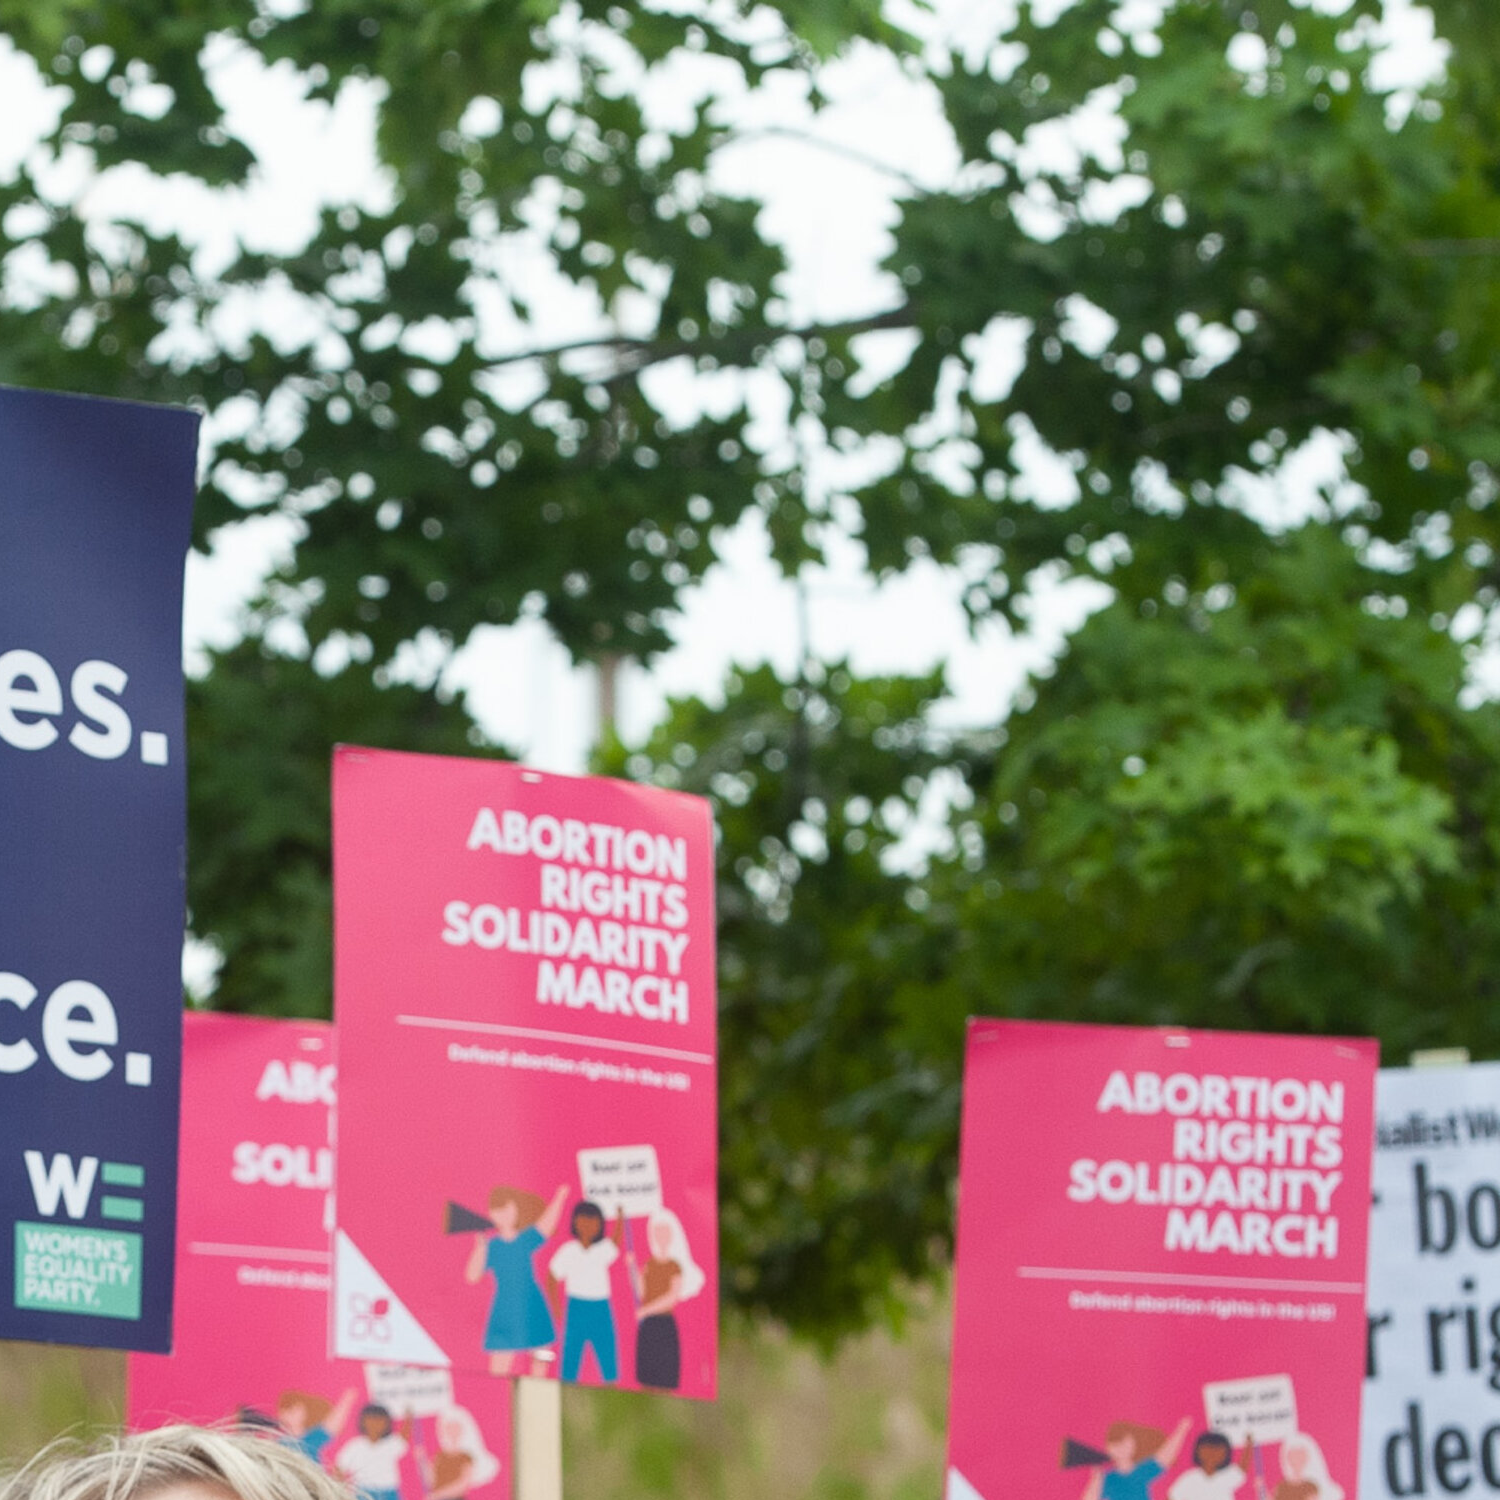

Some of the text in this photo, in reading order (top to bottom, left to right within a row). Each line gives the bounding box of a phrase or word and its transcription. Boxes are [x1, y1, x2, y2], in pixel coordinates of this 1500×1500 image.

[467, 807, 687, 880] ABORTION
[540, 864, 687, 928] RIGHTS
[441, 902, 688, 974] SOLIDARITY
[537, 962, 688, 1023] MARCH
[1096, 1070, 1343, 1123] ABORTION
[1173, 1120, 1342, 1168] RIGHTS
[1067, 1159, 1342, 1212] SOLIDARITY
[1165, 1209, 1338, 1258] MARCH
[24, 1253, 134, 1287] EQUALITY
